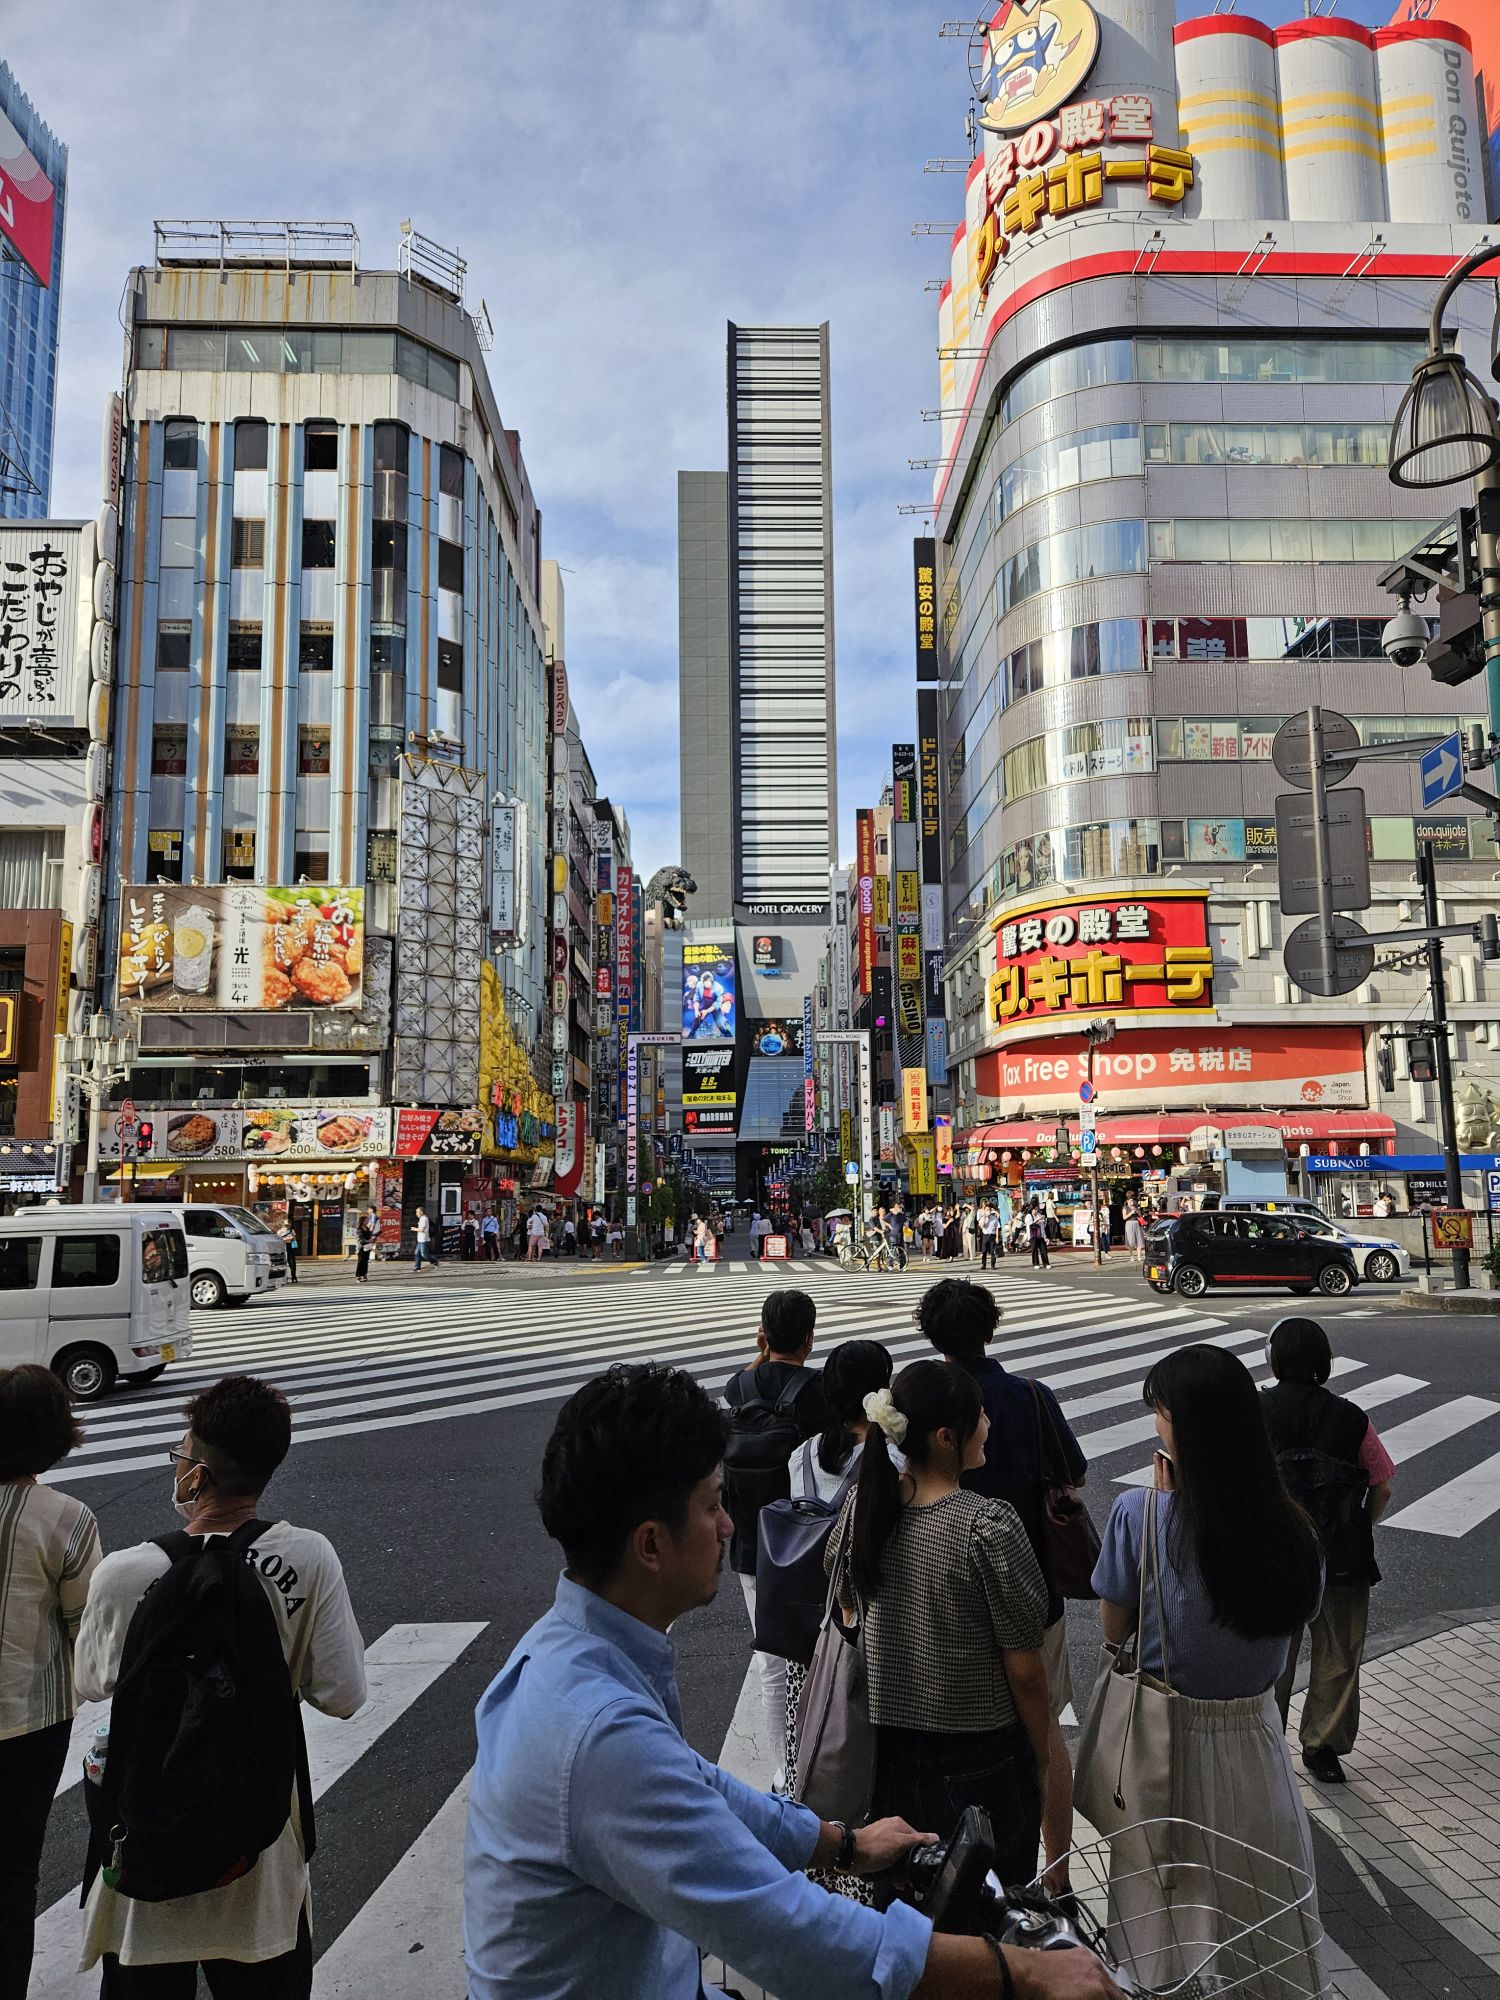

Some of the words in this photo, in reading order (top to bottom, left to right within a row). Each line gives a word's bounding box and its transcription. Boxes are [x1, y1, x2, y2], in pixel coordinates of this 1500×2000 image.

[1444, 49, 1462, 104] Don
[1447, 115, 1473, 220] Quijote
[25, 542, 68, 703] おやじが喜ぶ
[918, 566, 934, 650] 驚安の殿堂
[1212, 737, 1238, 758] 新宿
[1246, 827, 1277, 845] 販売
[1416, 824, 1467, 840] don.quijote
[901, 874, 910, 903] 生ビール
[749, 905, 779, 914] HOTEL
[780, 904, 824, 914] GRACERY
[618, 872, 630, 978] カラオケ歌広場
[901, 926, 915, 934] 4F
[1002, 904, 1150, 958] 驚安の殿堂
[130, 897, 149, 1000] レモンサワー
[233, 947, 250, 964] 光
[901, 937, 917, 966] 麻雀
[231, 990, 249, 1004] 4F
[900, 982, 921, 1031] CASINO
[1002, 1063, 1021, 1088] Tax
[1024, 1057, 1069, 1084] Free
[1168, 1046, 1253, 1074] 免税店
[628, 1056, 637, 1128] GODZILLA
[221, 1113, 229, 1129] そば
[400, 1114, 432, 1122] お好み焼き
[700, 1112, 733, 1122] MARUHAN
[806, 1087, 814, 1132] マルハン
[861, 1064, 870, 1159] ゴジラロード
[230, 1112, 239, 1143] かき揚げ
[558, 1106, 568, 1148] トラノコ
[628, 1136, 637, 1170] ROAD
[1314, 1158, 1370, 1168] SUBNADE
[1409, 1181, 1425, 1189] CBD
[1425, 1180, 1448, 1188] HILLS
